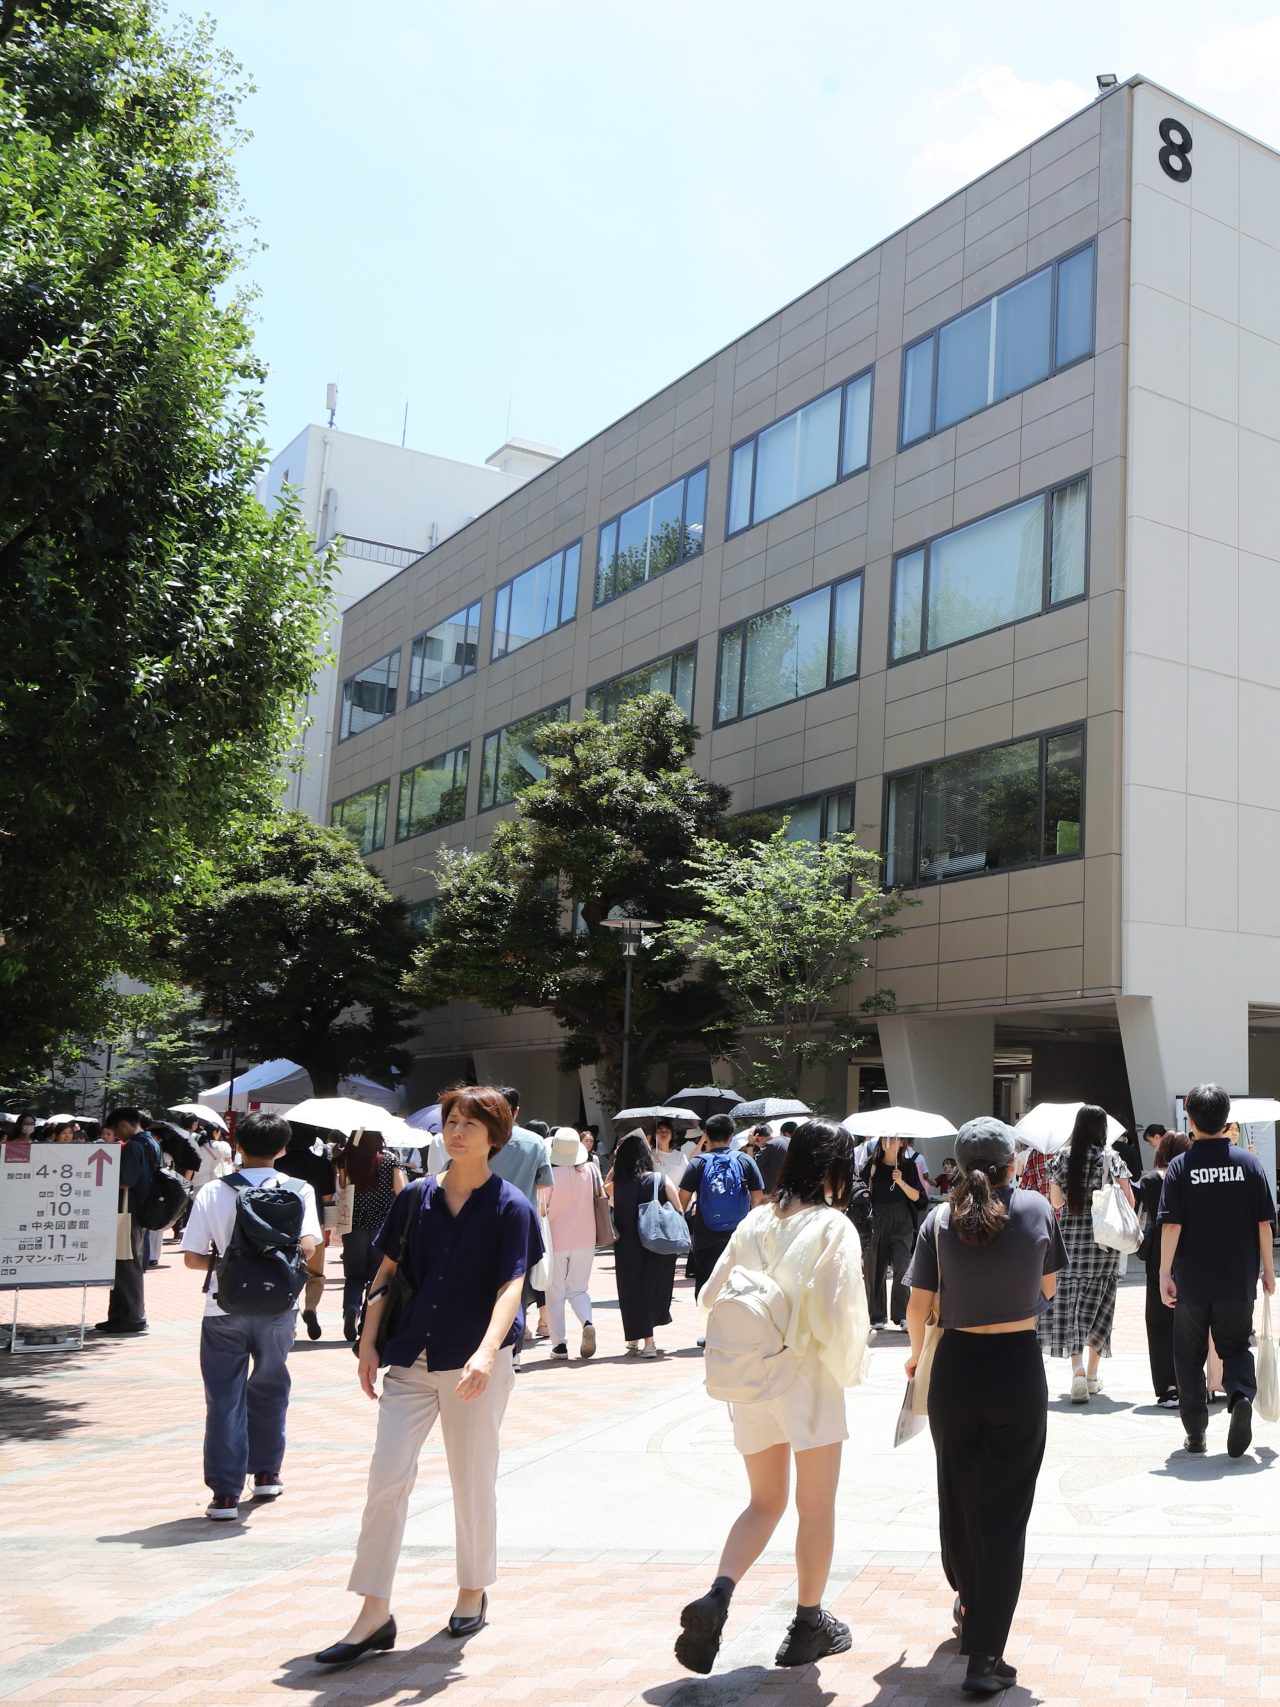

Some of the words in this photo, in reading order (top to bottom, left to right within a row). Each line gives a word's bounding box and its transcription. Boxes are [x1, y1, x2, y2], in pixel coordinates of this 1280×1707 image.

[1159, 118, 1192, 183] 8
[1190, 1166, 1245, 1185] SOPHIA
[32, 1220, 89, 1230] 中央図書館
